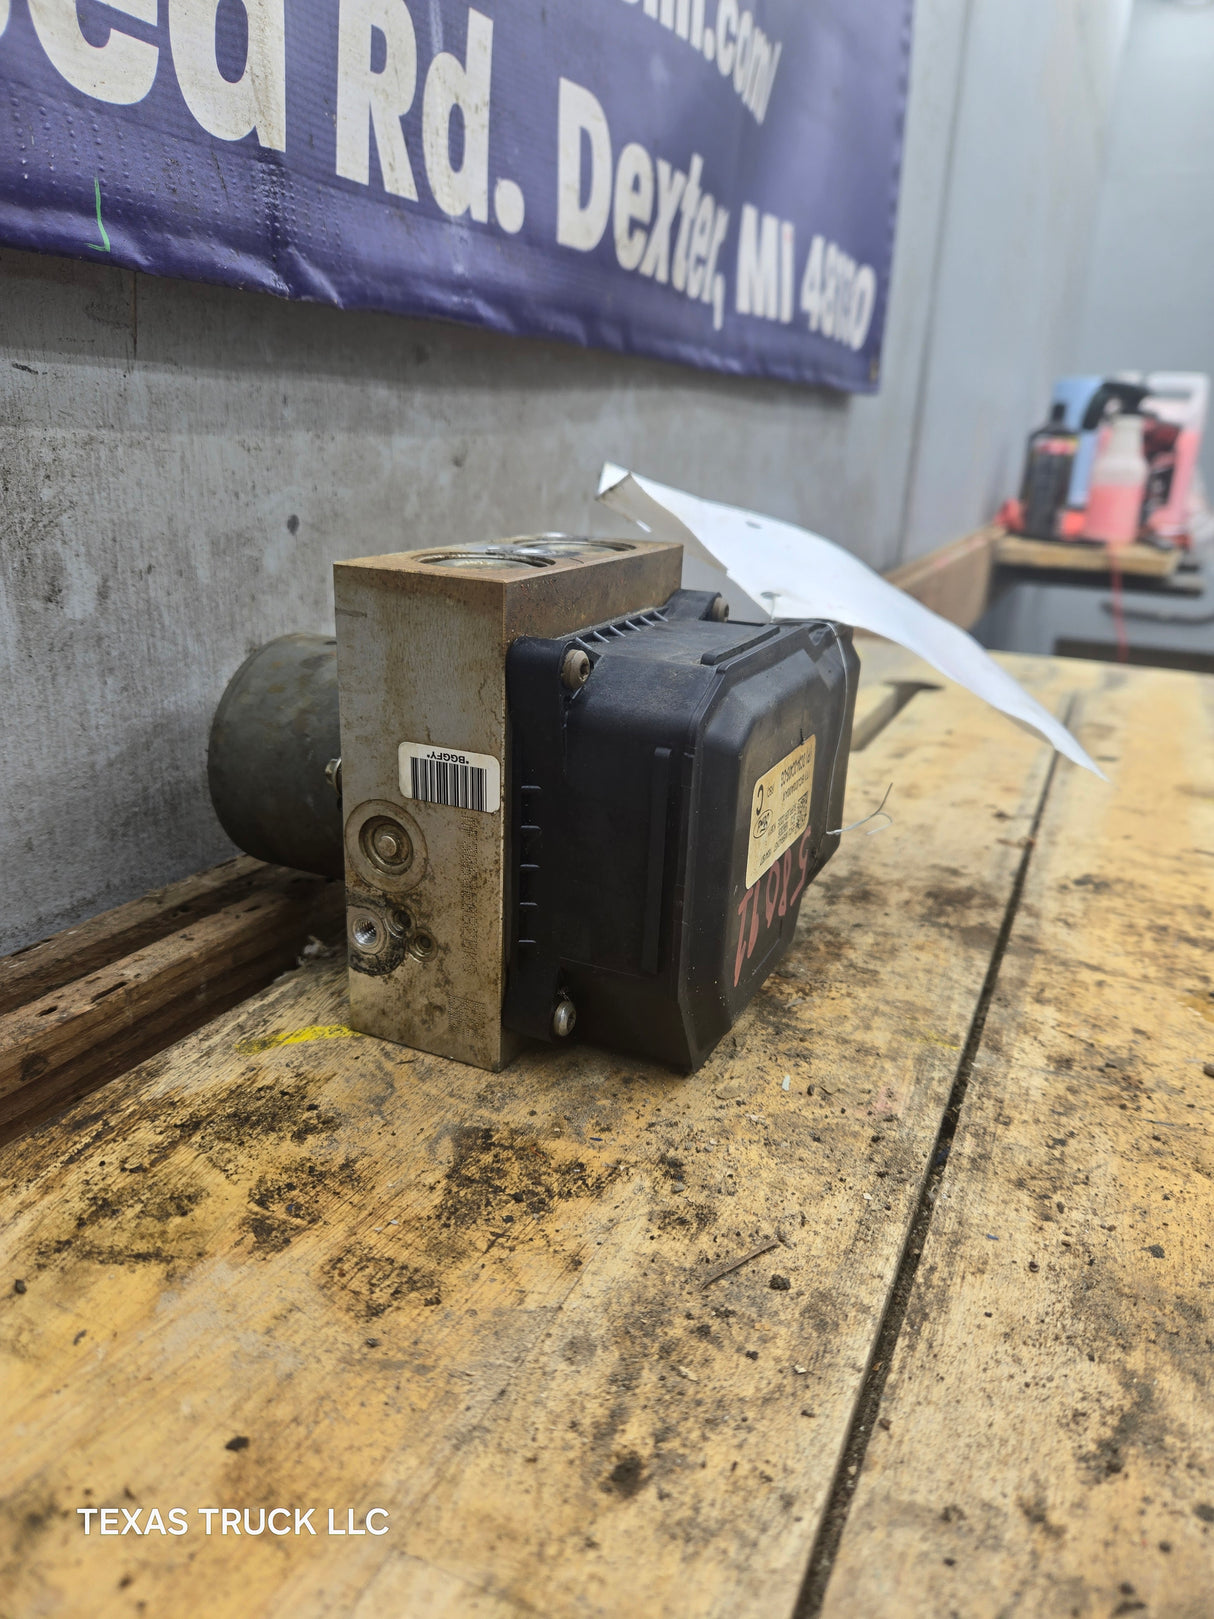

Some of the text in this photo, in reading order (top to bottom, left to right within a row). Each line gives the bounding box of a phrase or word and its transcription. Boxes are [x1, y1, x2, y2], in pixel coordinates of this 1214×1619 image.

[336, 0, 526, 234] Rd.
[556, 76, 730, 331] Dexter,
[736, 203, 795, 324] MI
